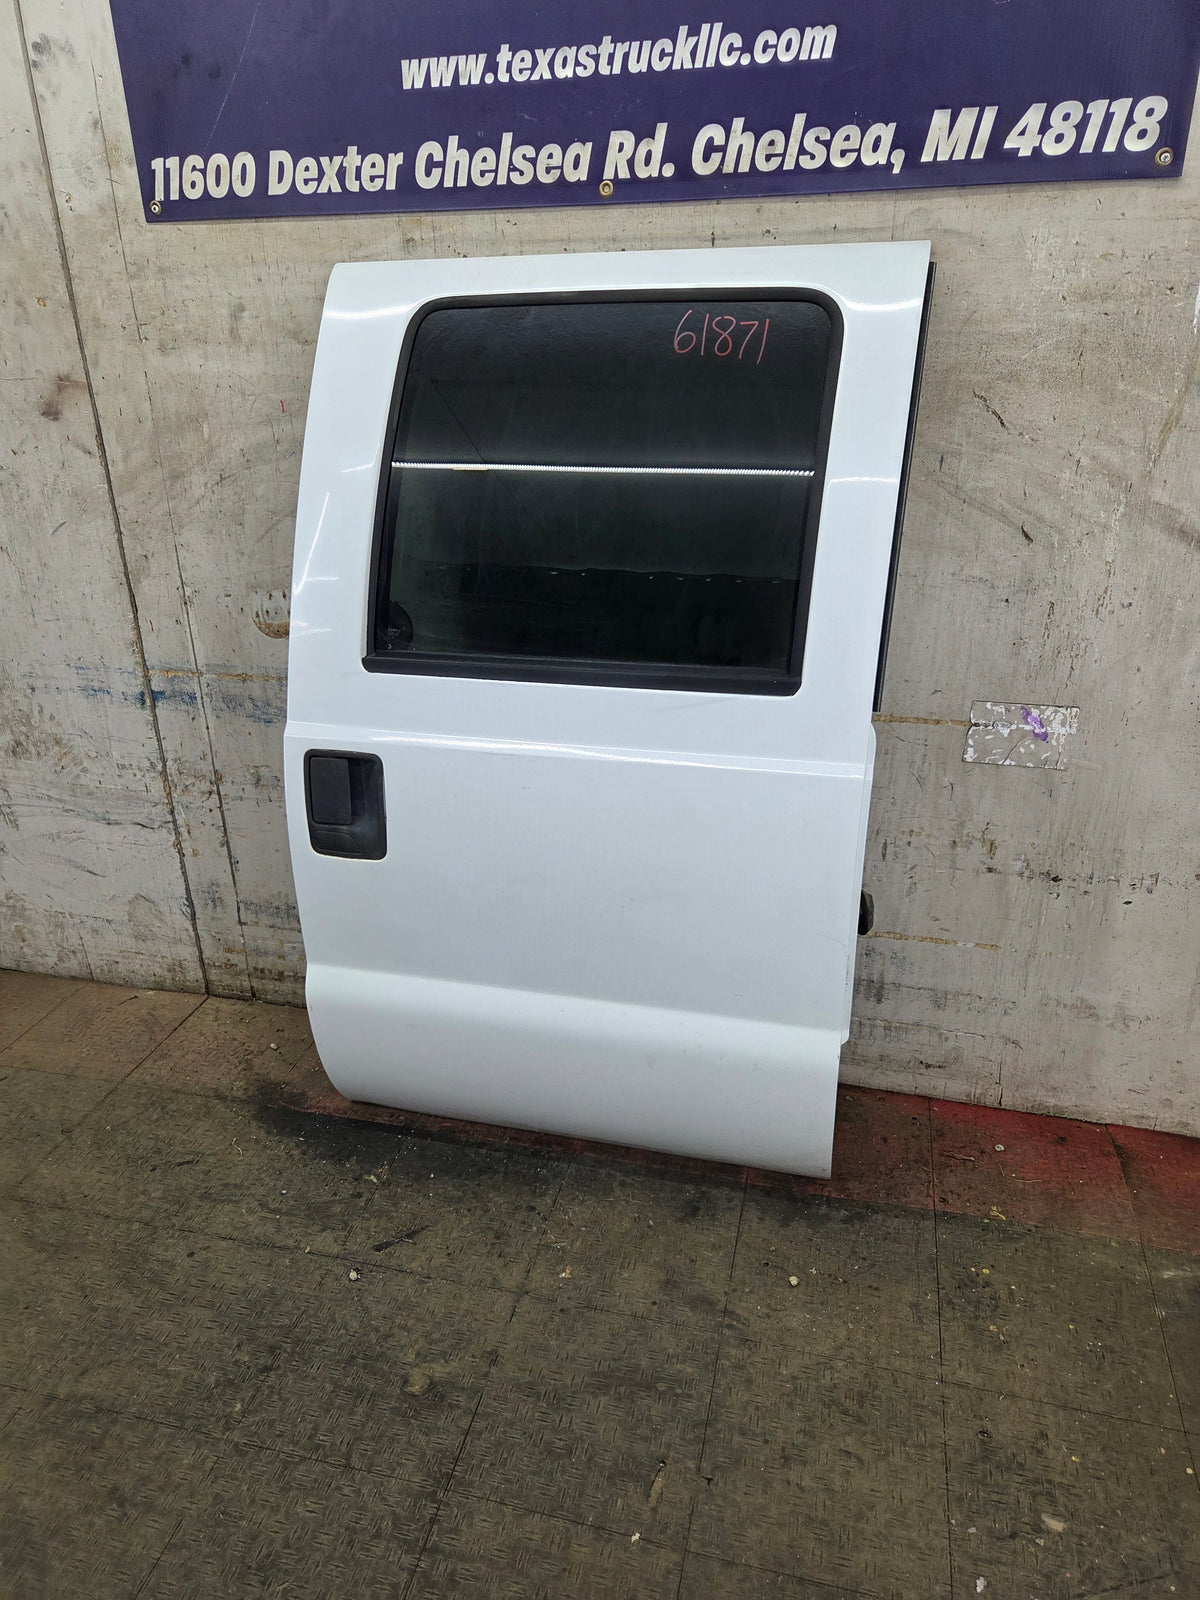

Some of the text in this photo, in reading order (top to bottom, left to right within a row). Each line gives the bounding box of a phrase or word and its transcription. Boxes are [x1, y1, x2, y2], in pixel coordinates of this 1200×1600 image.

[400, 22, 837, 90] www.texastruckllc.com
[151, 95, 1169, 202] 11600 Dexter Chelsea Rd. Chelsea, MI 48118
[673, 309, 770, 366] 61871
